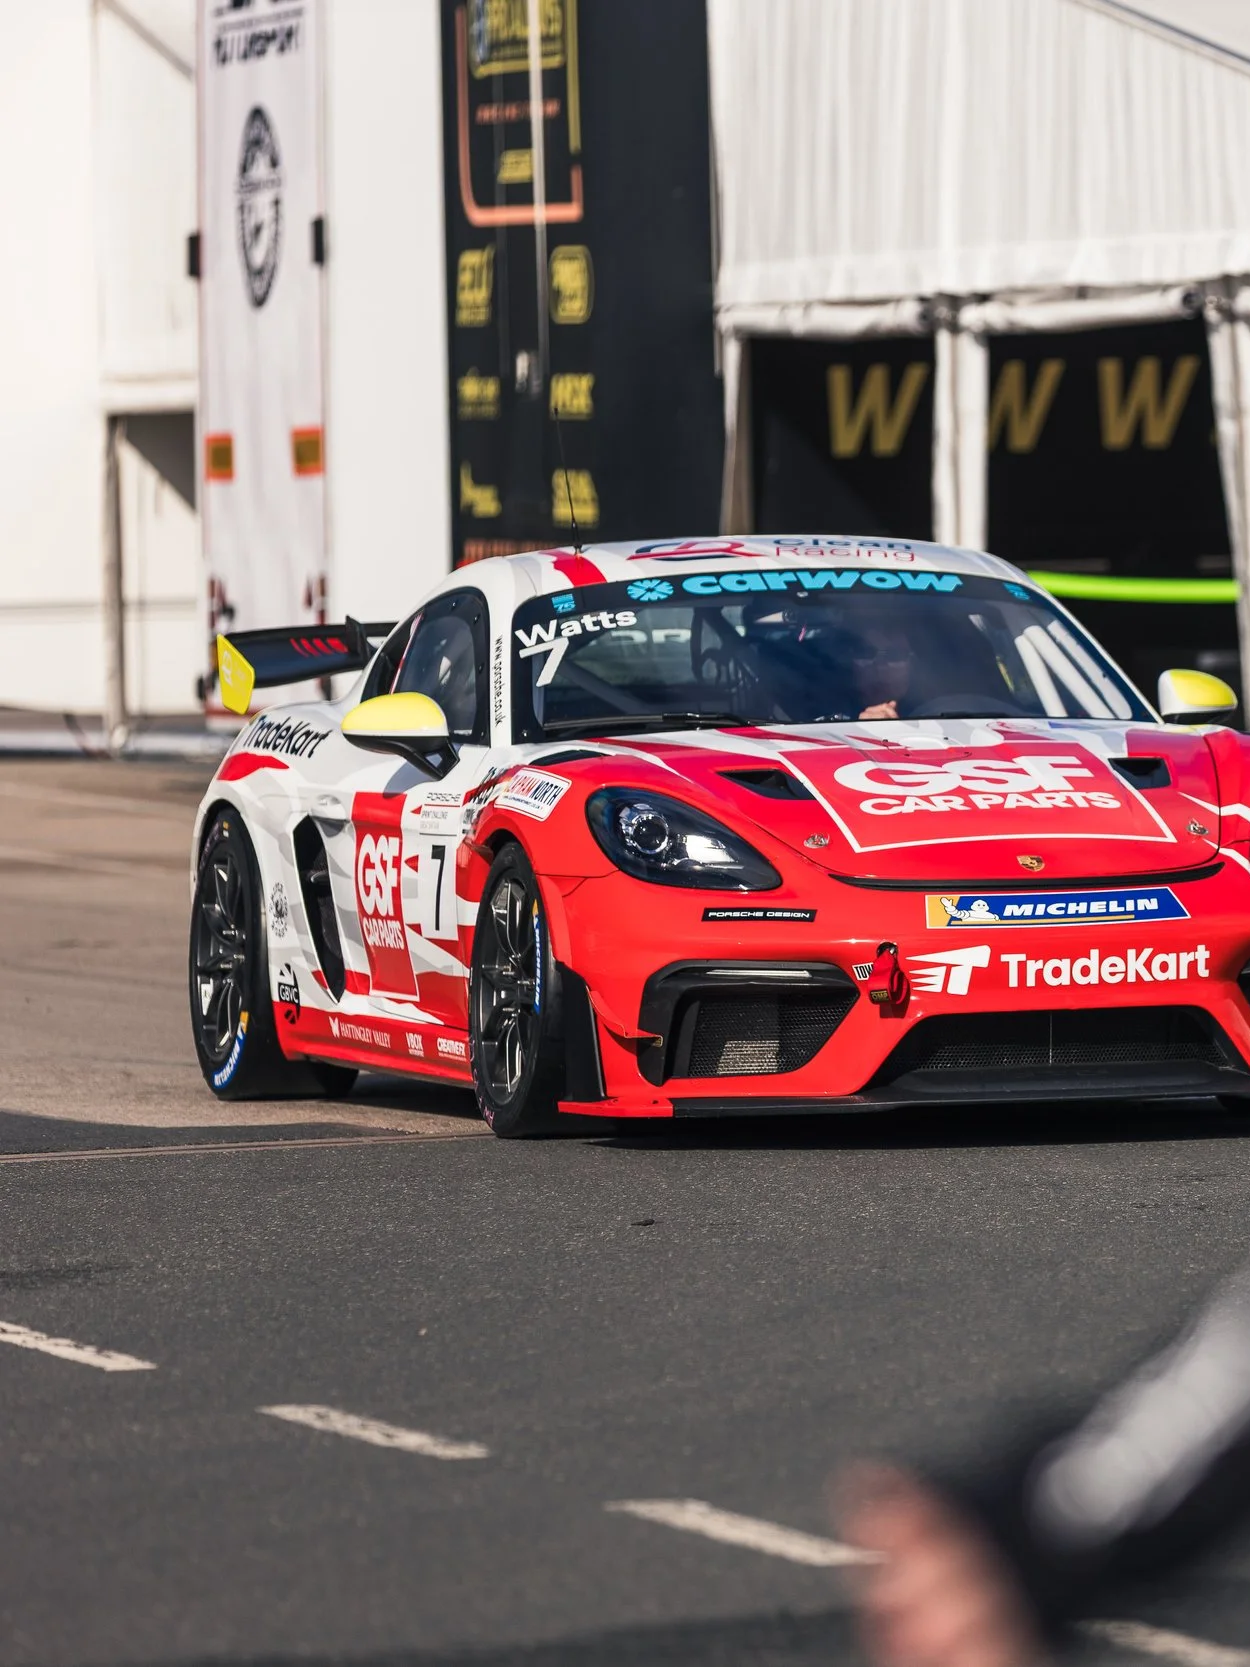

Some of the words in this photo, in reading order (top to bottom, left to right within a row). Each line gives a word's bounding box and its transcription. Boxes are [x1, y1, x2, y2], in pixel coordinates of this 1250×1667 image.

[774, 537, 912, 550] Clean
[776, 546, 915, 562] Racing
[682, 570, 963, 595] carwow
[514, 611, 638, 647] Watts
[518, 637, 570, 688] 7
[244, 714, 333, 759] TradeKart
[833, 755, 1095, 797] GSF
[526, 780, 565, 807] NORTH
[859, 793, 974, 816] CAR
[967, 790, 1122, 811] PARTS
[357, 833, 400, 918] GSF
[430, 844, 446, 931] 7
[708, 910, 764, 918] PORSCHE
[766, 911, 810, 919] DESIGN
[1002, 897, 1159, 917] MICHELIN
[363, 916, 382, 947] CAR
[378, 919, 405, 950] PARTS
[1000, 943, 1210, 988] TradeKart
[279, 984, 300, 1005] GBVC
[339, 1022, 373, 1045] HATTINGLEY
[372, 1029, 392, 1049] VALLEY
[405, 1031, 424, 1051] VBOX
